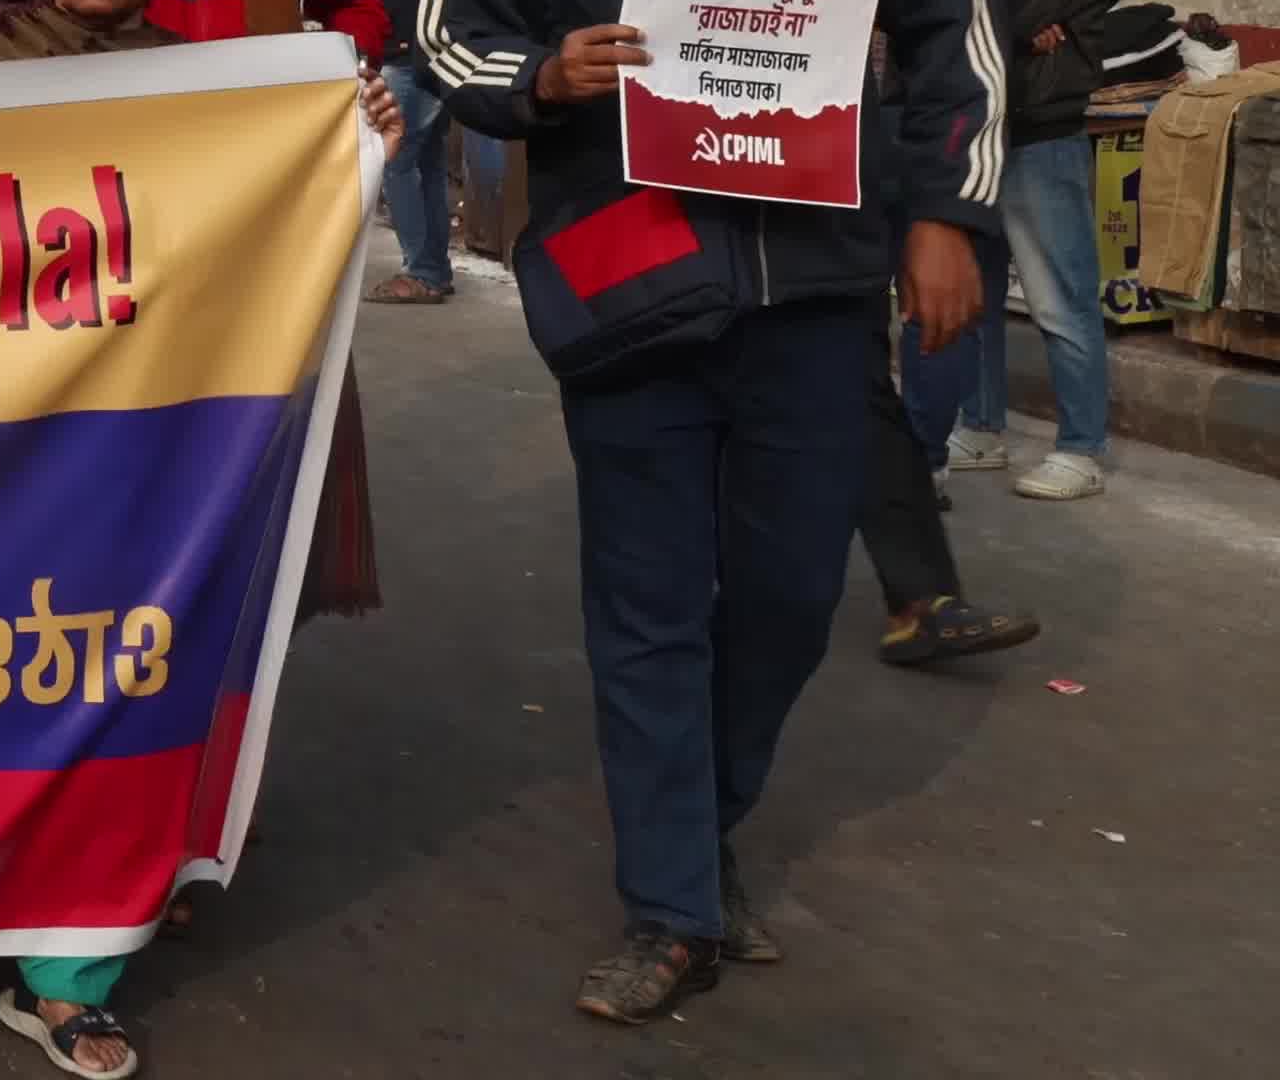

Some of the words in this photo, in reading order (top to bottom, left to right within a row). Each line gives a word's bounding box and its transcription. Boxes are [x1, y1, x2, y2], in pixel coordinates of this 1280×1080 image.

[689, 3, 747, 34] "রাজা
[748, 3, 785, 36] চাই
[784, 8, 819, 38] না"
[679, 39, 725, 67] মার্কিন
[726, 47, 811, 74] সাম্রাজ্যবাদ
[698, 70, 744, 100] নিপাত
[722, 132, 785, 167] CPIML
